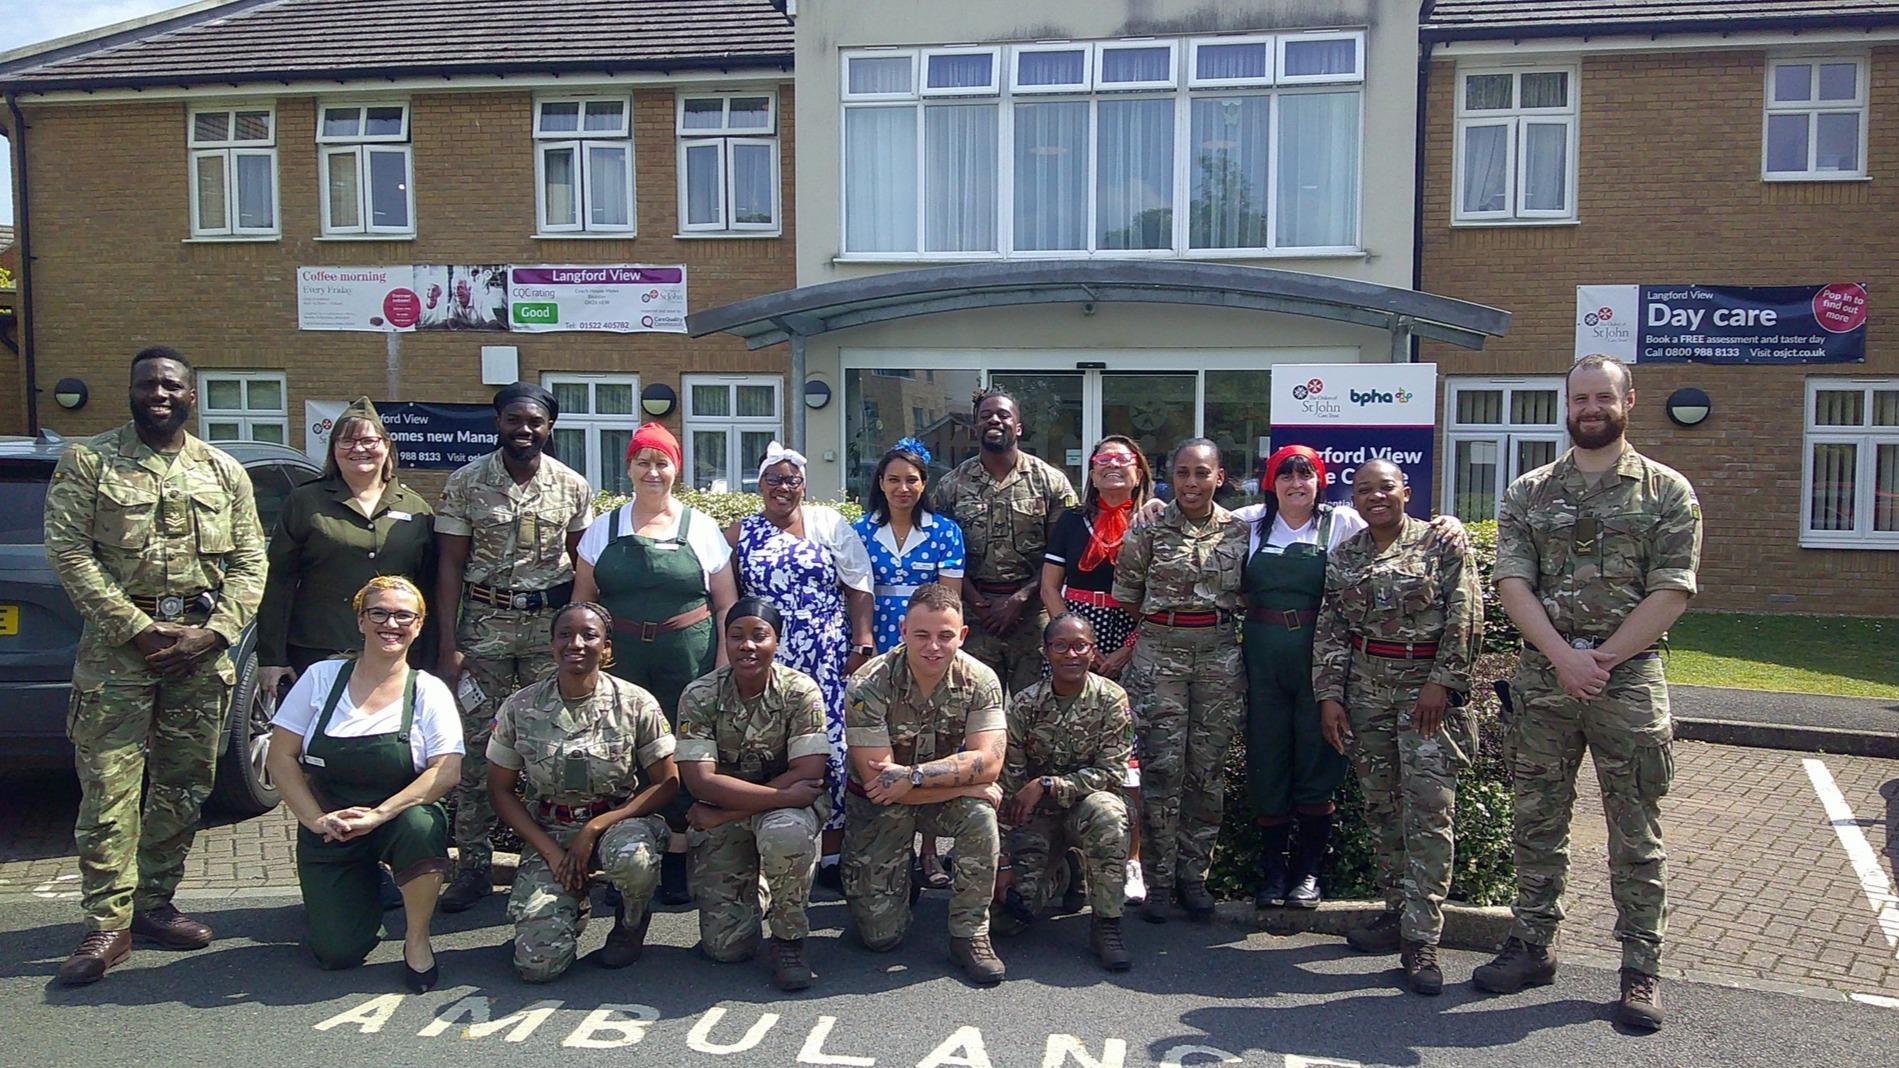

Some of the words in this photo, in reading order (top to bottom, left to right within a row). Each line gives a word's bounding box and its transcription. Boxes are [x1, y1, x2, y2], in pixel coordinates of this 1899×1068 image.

[302, 271, 337, 281] Coffee
[340, 271, 386, 283] morning
[552, 270, 606, 283] Langford
[609, 270, 641, 281] View
[303, 286, 325, 294] Every
[328, 286, 352, 295] Friday
[512, 288, 530, 298] CQC
[532, 288, 555, 299] rating
[1647, 291, 1688, 300] Langford
[1690, 291, 1714, 299] View
[1822, 289, 1841, 301] Pop
[1843, 291, 1852, 301] in
[1854, 296, 1864, 304] to
[521, 306, 550, 318] Good
[1822, 300, 1841, 310] find
[1842, 304, 1859, 314] out
[1648, 303, 1705, 331] Day
[1713, 308, 1777, 326] care
[1826, 311, 1849, 323] more
[1605, 327, 1629, 338] John
[1646, 335, 1670, 343] Book
[1680, 335, 1704, 343] FREE
[1760, 335, 1778, 344] and
[1809, 335, 1826, 346] day
[1645, 348, 1663, 356] Call
[1665, 348, 1692, 356] 0800
[1694, 348, 1713, 356] 988
[1715, 348, 1740, 357] 8133
[1750, 348, 1771, 357] Visit
[1773, 348, 1826, 358] osjct.co.uk
[1350, 389, 1393, 406] bpha
[1302, 401, 1314, 412] St
[1314, 401, 1340, 415] John
[380, 413, 400, 424] ford
[404, 414, 428, 424] View
[388, 432, 423, 442] omes
[427, 434, 453, 442] new
[457, 431, 499, 445] Manag
[400, 452, 416, 461] 988
[418, 452, 441, 462] 8133
[447, 453, 466, 462] Visit
[1370, 447, 1423, 464] View
[313, 994, 1361, 1068] AMBULAN
